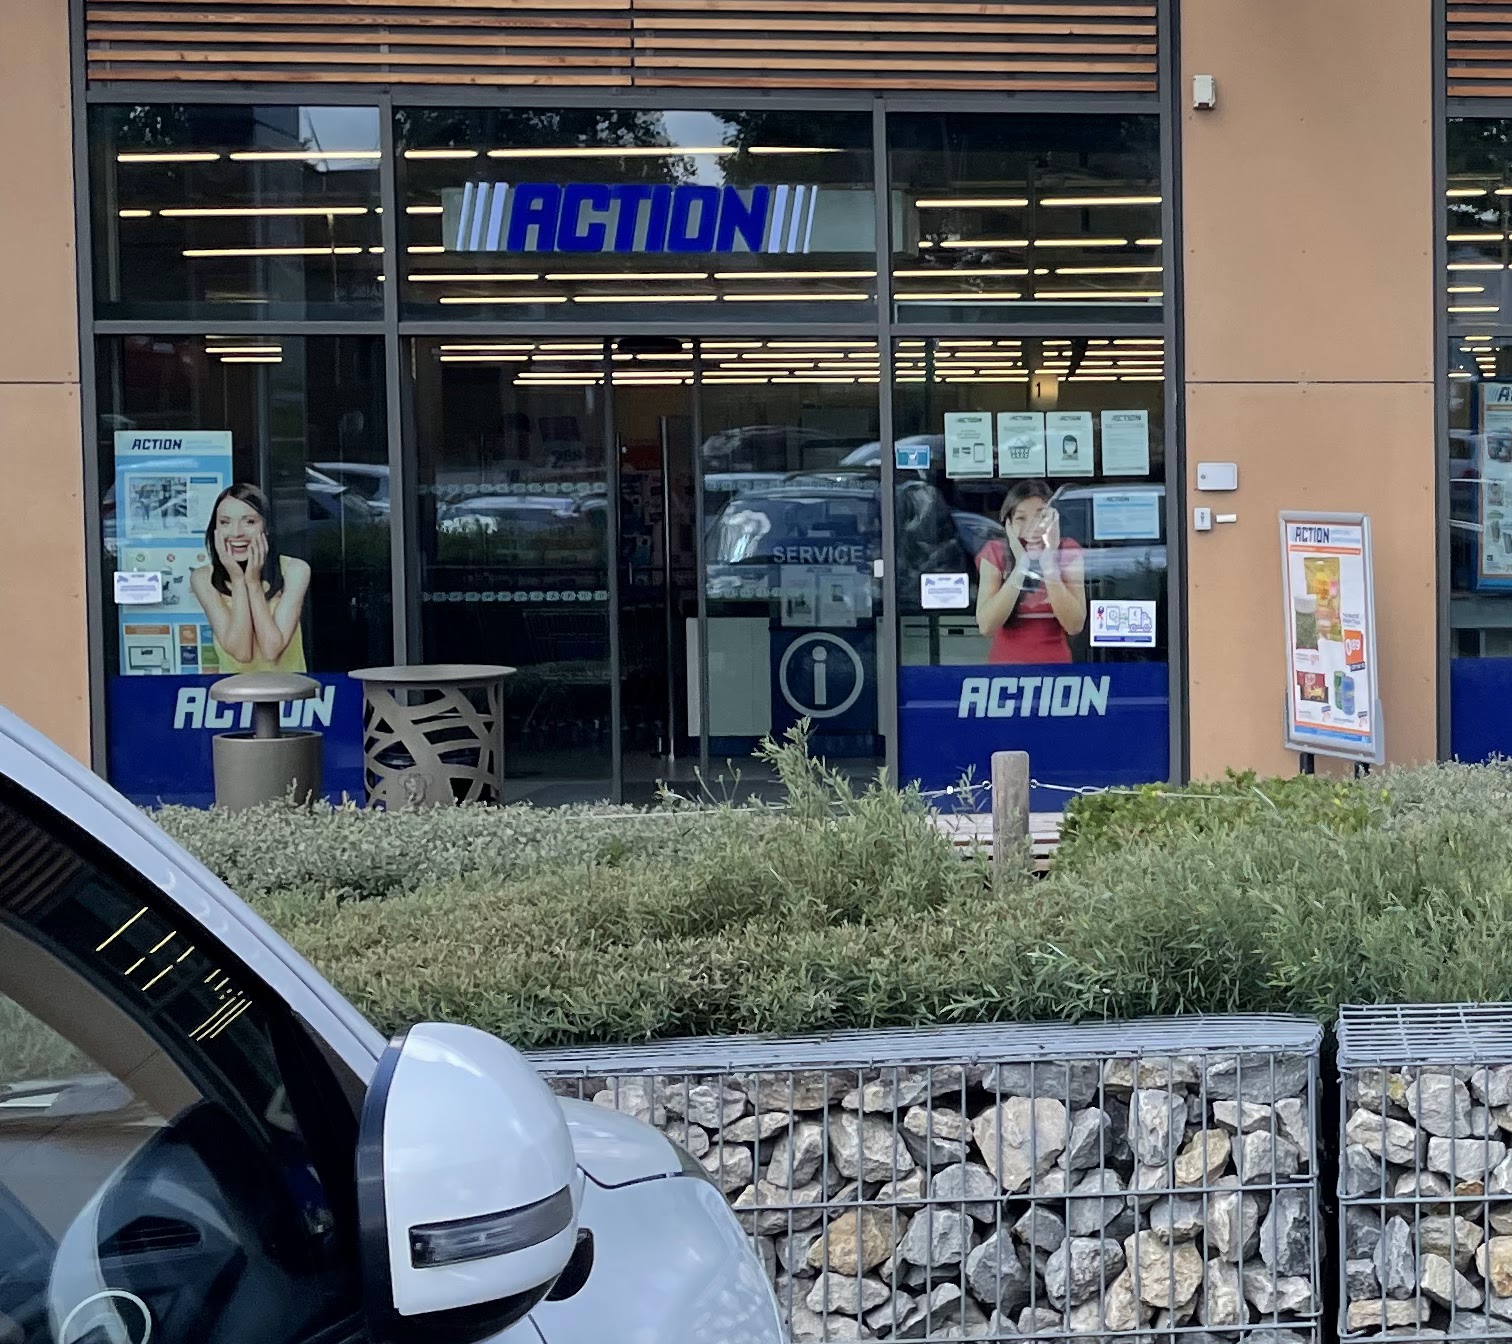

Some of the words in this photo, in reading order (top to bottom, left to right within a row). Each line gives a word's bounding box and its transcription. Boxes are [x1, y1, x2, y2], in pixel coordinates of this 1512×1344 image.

[507, 182, 769, 253] ACTION
[1034, 382, 1042, 398] 1
[131, 438, 183, 451] ACTION
[1294, 526, 1330, 544] ACTION
[772, 544, 865, 564] SERVICE
[957, 675, 1111, 718] ACTION
